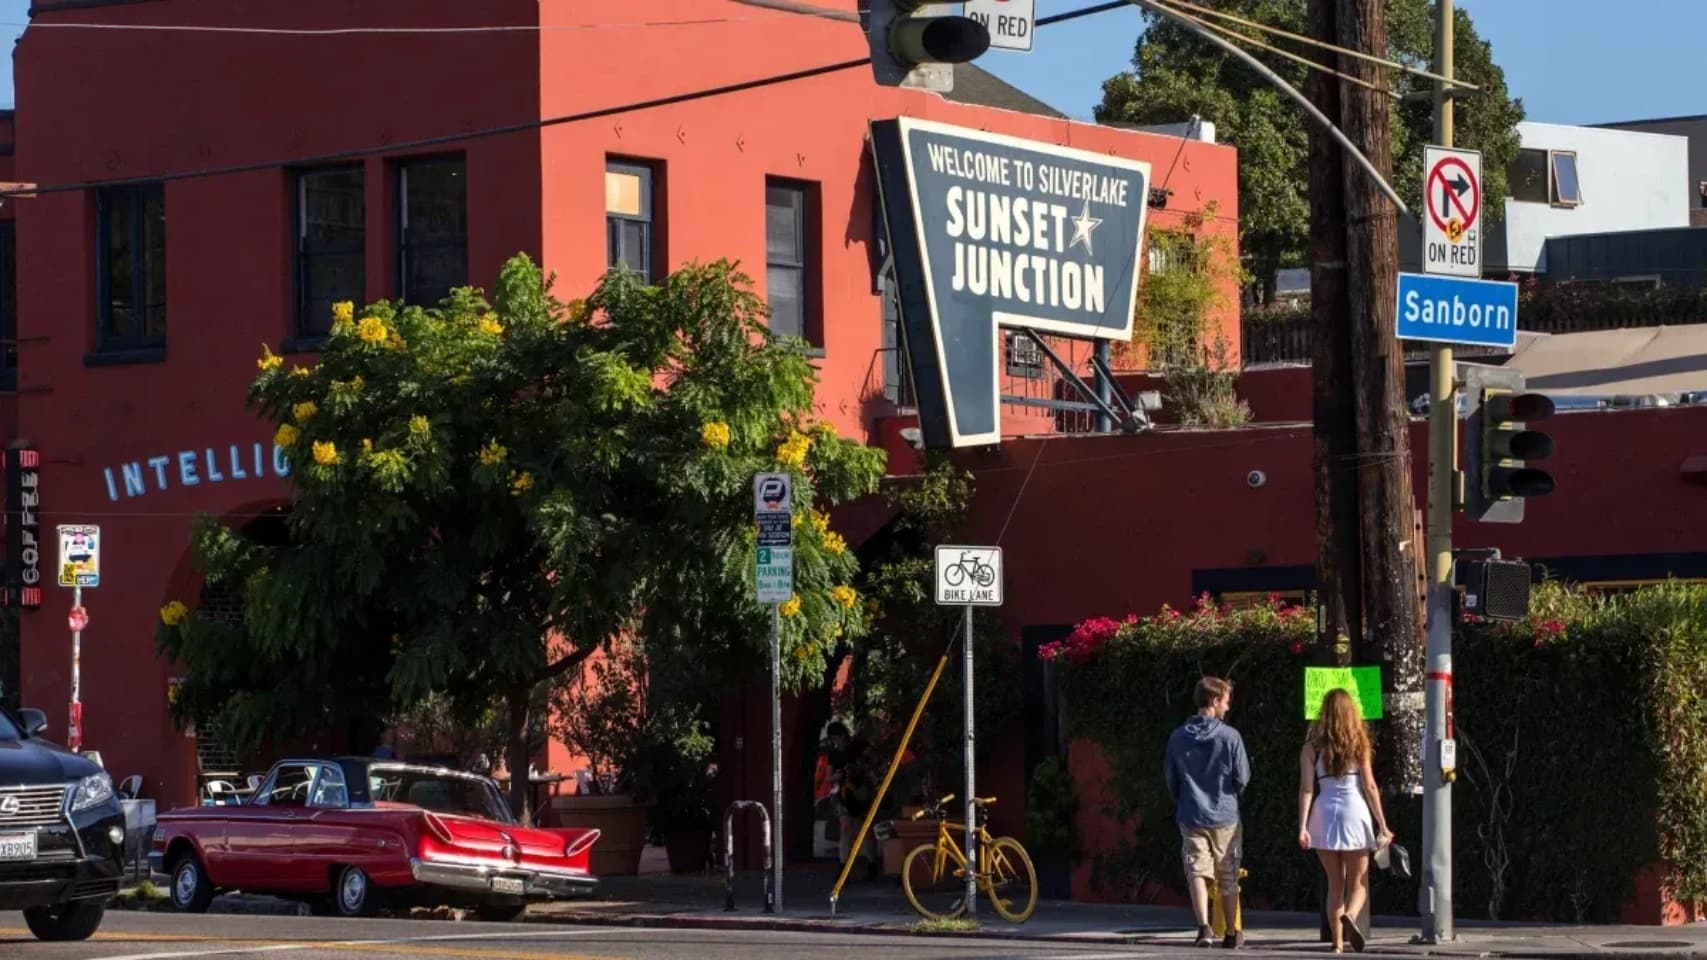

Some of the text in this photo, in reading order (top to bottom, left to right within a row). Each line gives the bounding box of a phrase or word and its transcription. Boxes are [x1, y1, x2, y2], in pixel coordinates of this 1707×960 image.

[997, 15, 1028, 38] RED
[927, 142, 1129, 207] WELCOME TO SILVERLAKE
[946, 185, 1068, 253] SUNSET
[1429, 242, 1476, 266] ON RED
[952, 242, 1105, 314] JUNCTION
[1404, 289, 1510, 330] Sanborn
[21, 471, 40, 584] COFFEE
[757, 566, 791, 577] PARKING
[760, 550, 767, 563] 2
[944, 589, 994, 601] BIKE LANE
